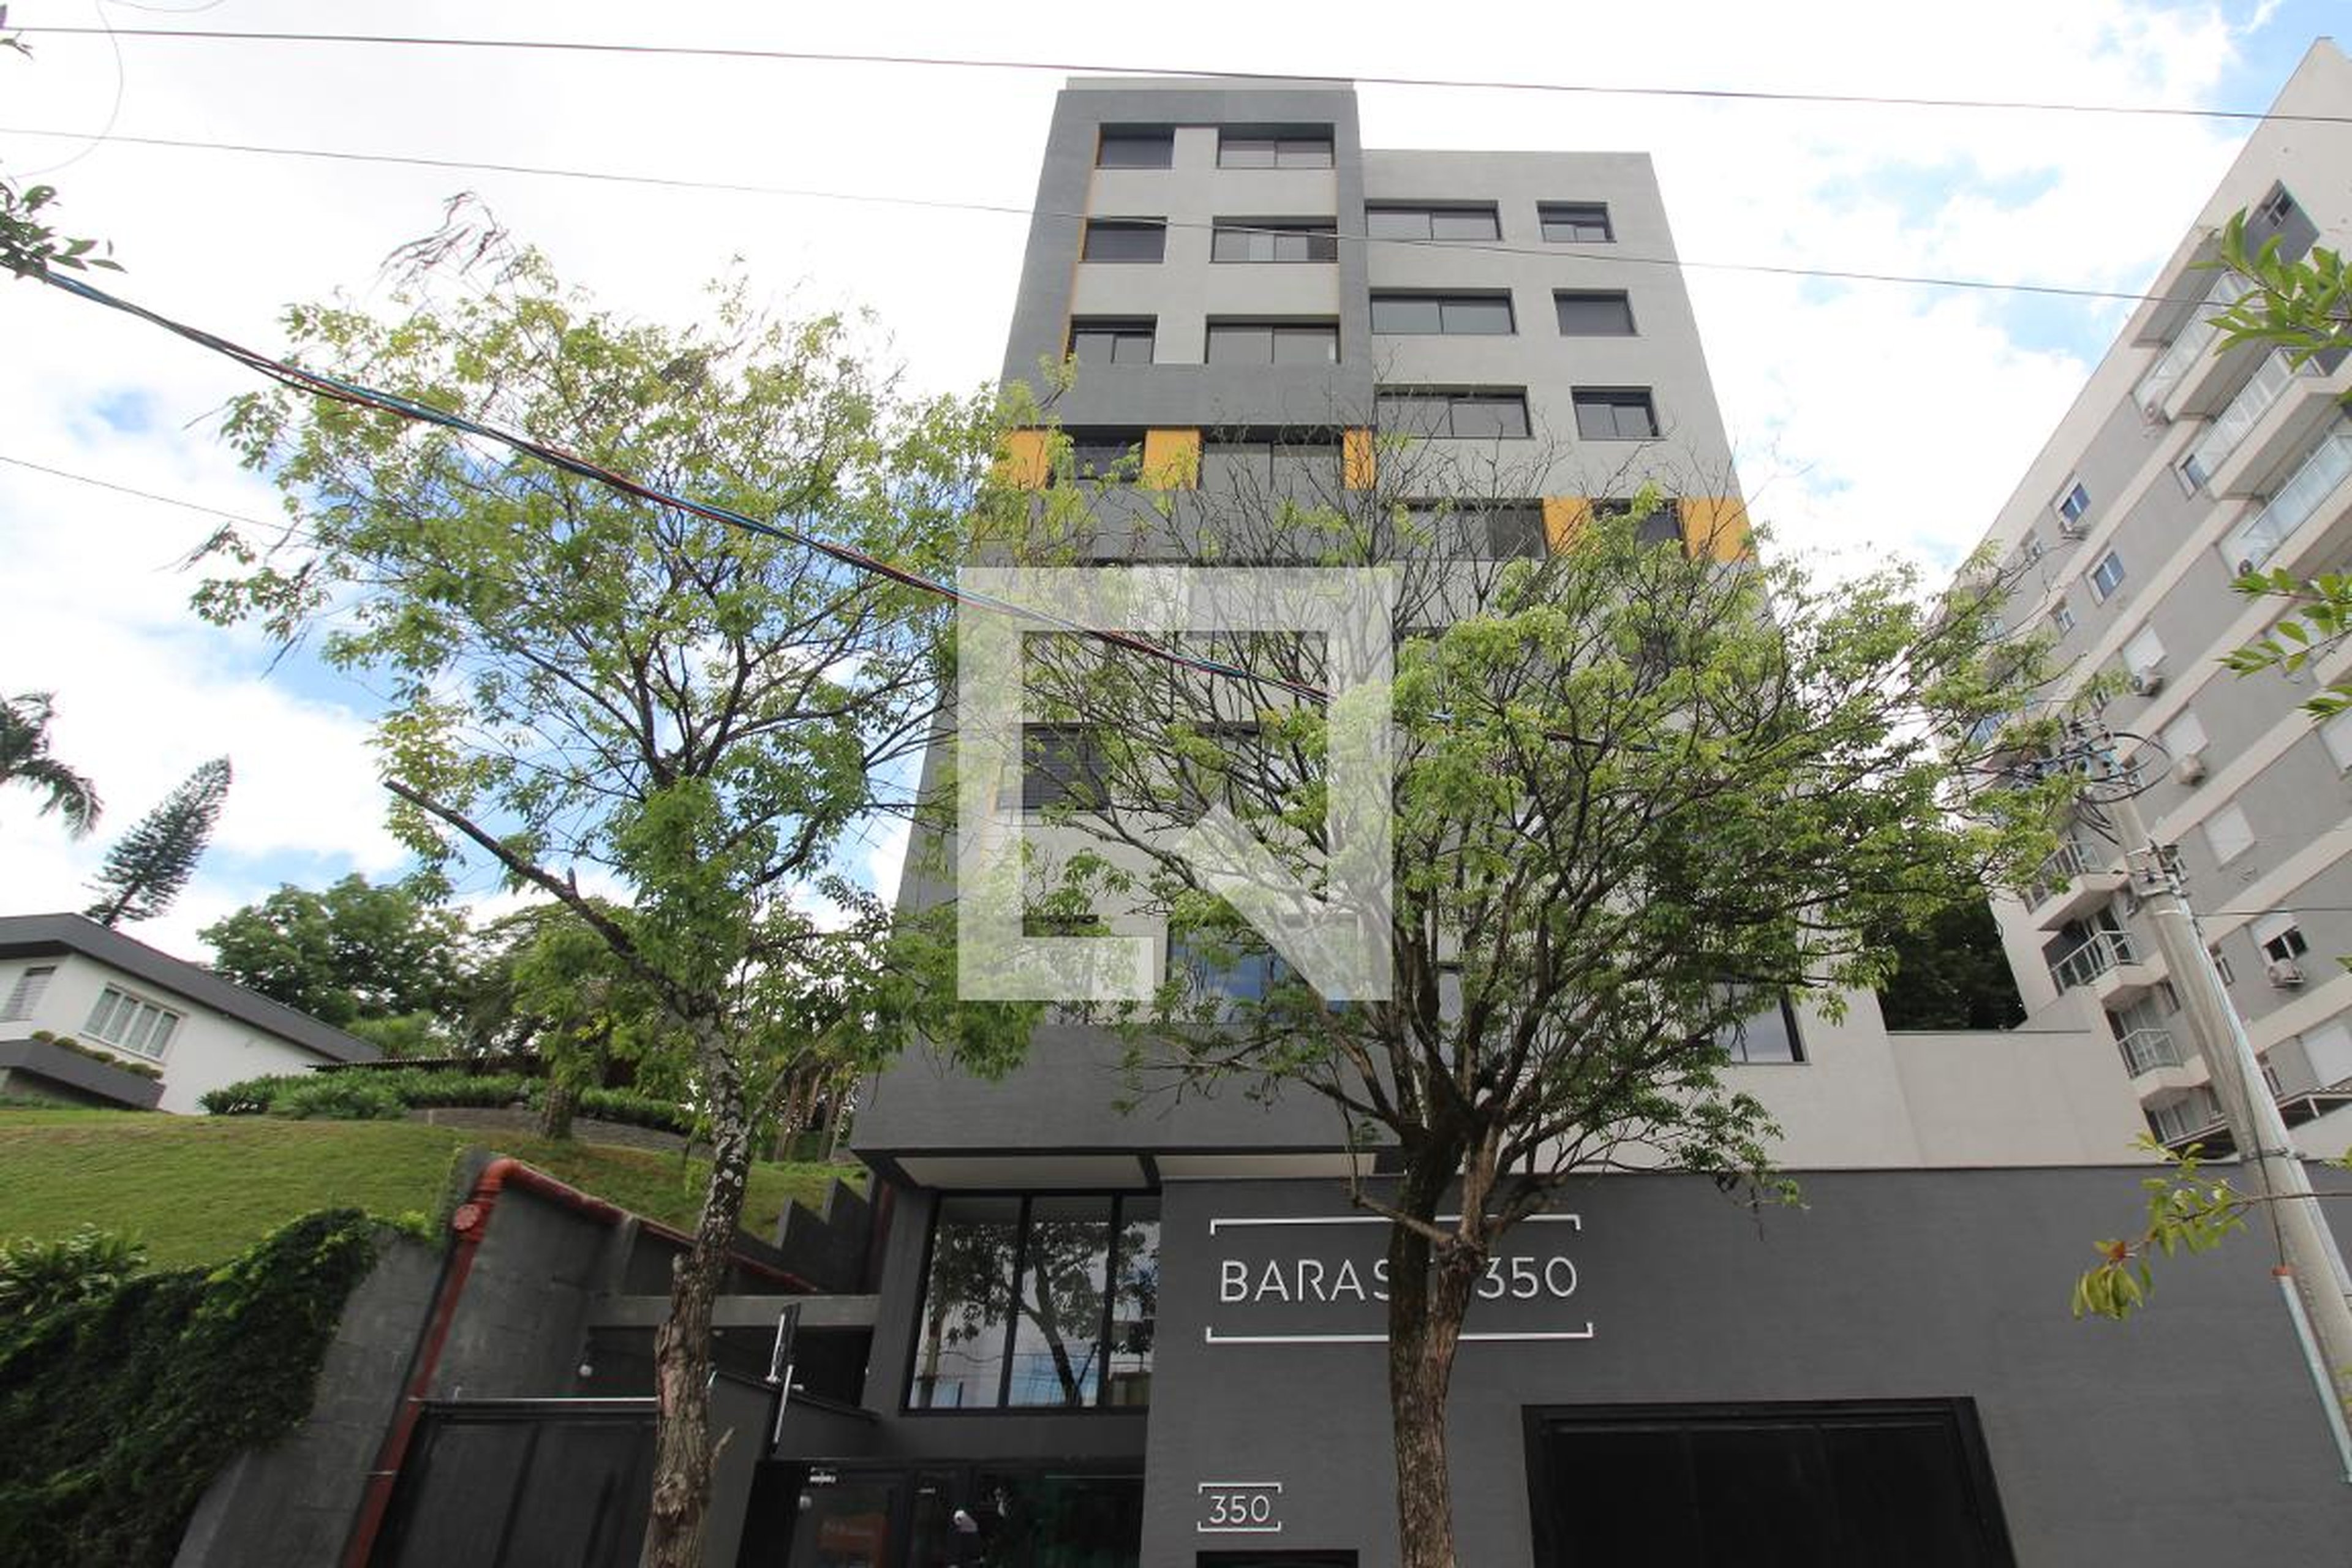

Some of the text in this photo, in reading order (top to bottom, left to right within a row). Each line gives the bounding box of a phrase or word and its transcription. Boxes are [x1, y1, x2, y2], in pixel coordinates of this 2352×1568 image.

[1220, 1256, 1577, 1302] BARAS 350
[1208, 1494, 1270, 1524] 350
